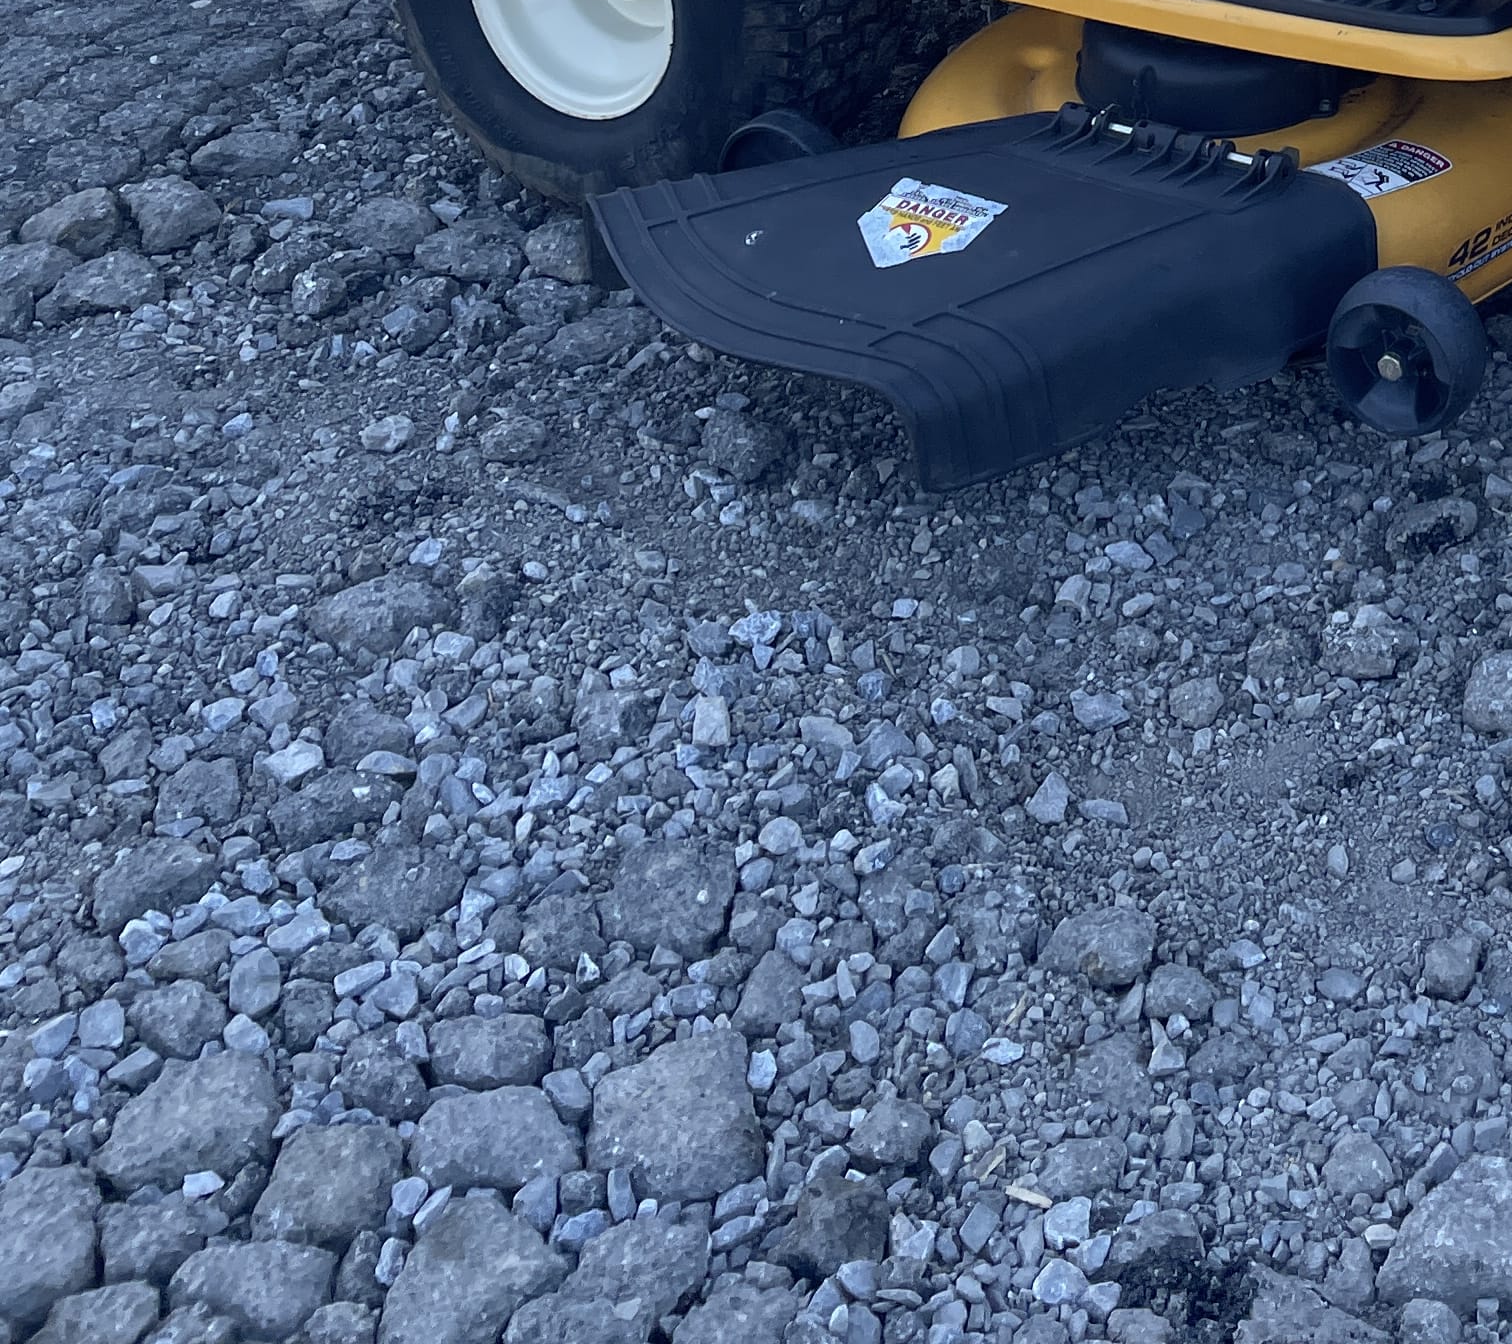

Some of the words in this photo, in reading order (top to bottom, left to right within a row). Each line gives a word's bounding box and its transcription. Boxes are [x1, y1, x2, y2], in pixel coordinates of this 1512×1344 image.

[1399, 144, 1446, 169] DANGER
[896, 199, 969, 226] DANGER
[1447, 226, 1493, 268] 42
